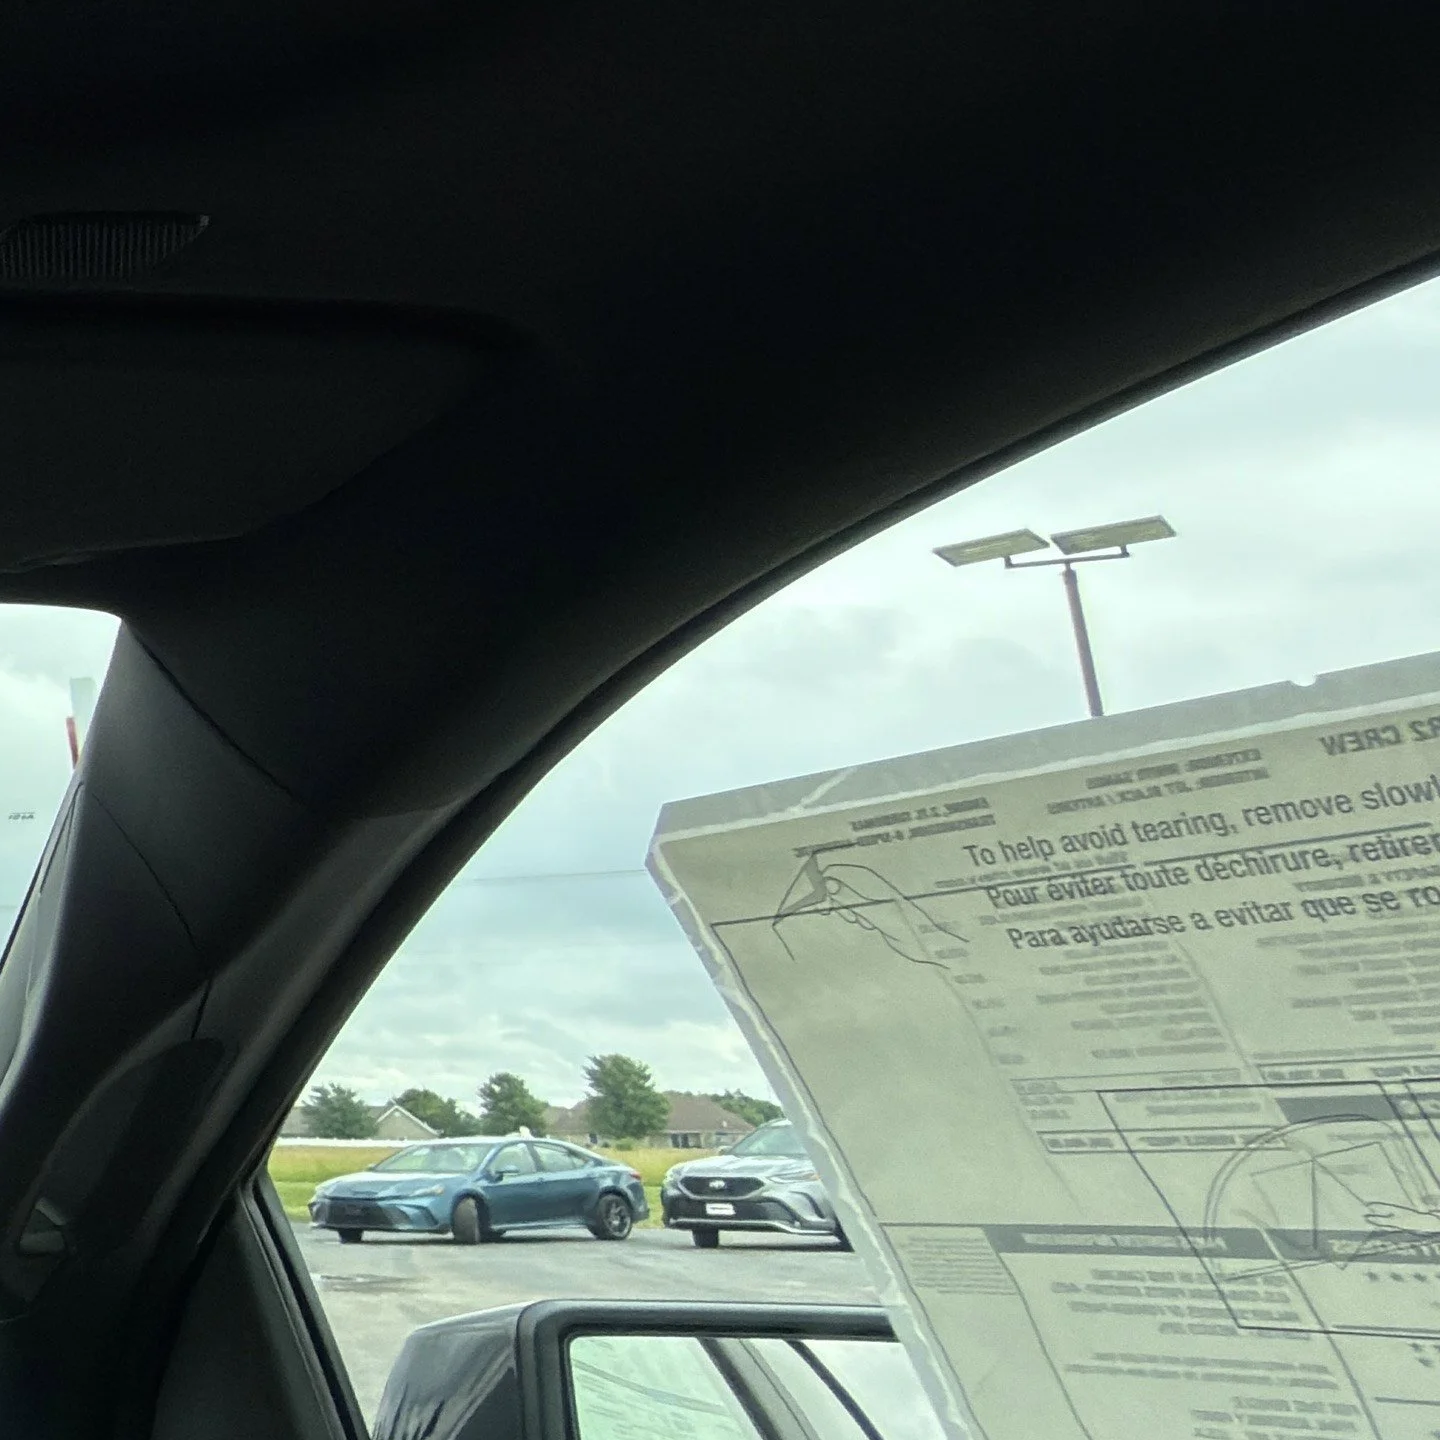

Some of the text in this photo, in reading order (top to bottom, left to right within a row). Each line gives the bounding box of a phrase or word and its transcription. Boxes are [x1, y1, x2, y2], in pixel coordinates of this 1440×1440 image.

[963, 844, 997, 868] To
[1001, 835, 1055, 863] help
[1058, 822, 1129, 854] avoid
[1131, 809, 1239, 845] tearing,
[1242, 791, 1354, 828] remove
[985, 884, 1041, 910] Pour
[1121, 862, 1191, 894] toute
[1007, 920, 1065, 950] Para
[1070, 910, 1187, 948] ayudarse
[1193, 912, 1212, 932] a
[1215, 897, 1296, 928] evitar
[1299, 891, 1356, 920] que
[1362, 890, 1401, 913] se
